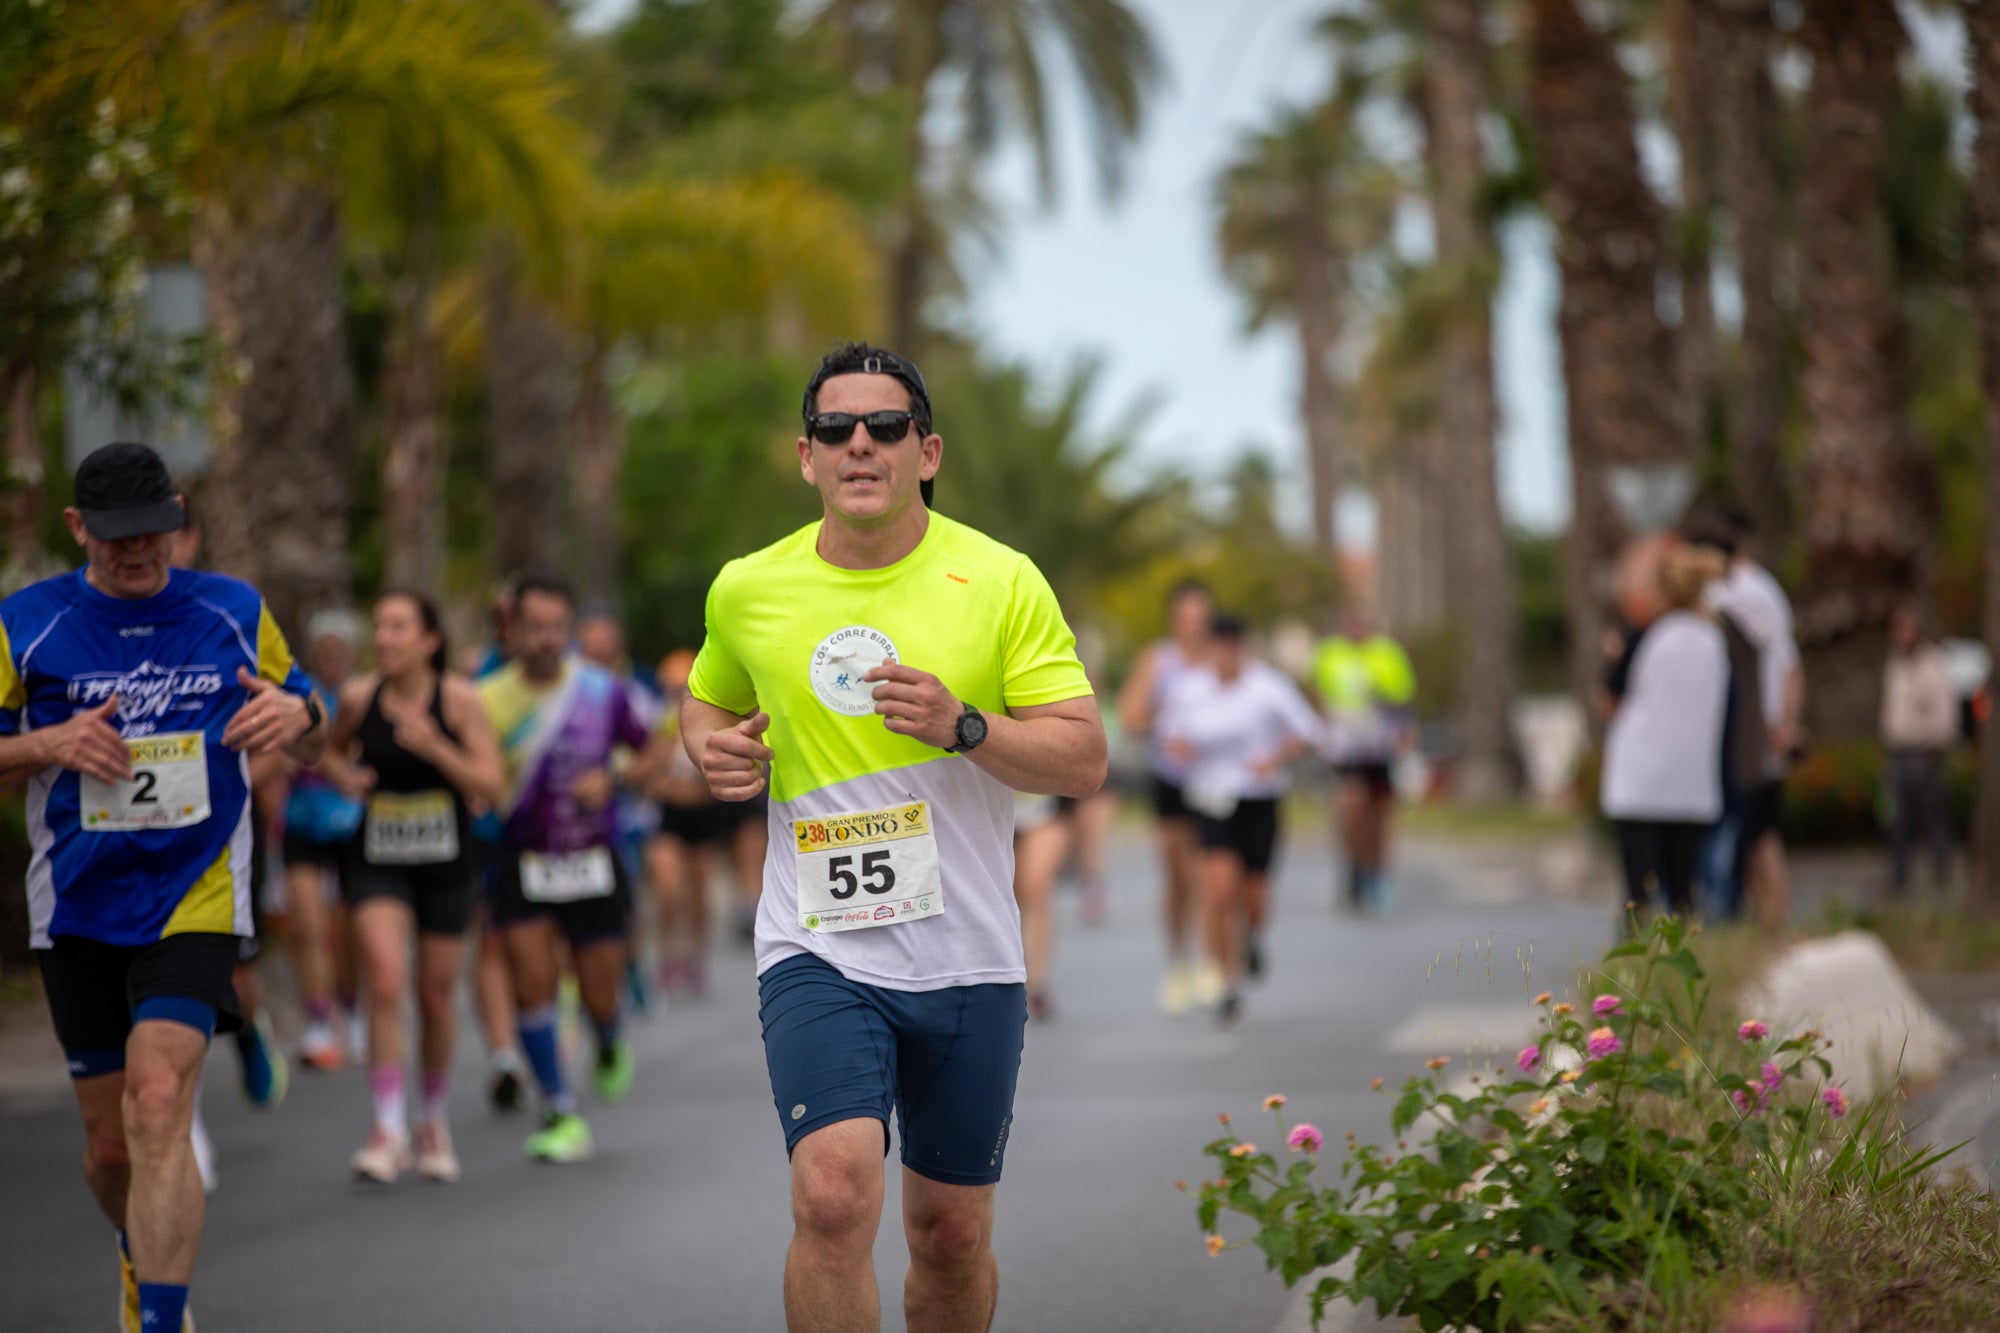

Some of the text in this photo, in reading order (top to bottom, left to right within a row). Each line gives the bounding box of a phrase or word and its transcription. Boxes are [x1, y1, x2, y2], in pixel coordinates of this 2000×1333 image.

[815, 646, 829, 666] LOS
[830, 629, 866, 645] CORRE
[130, 771, 158, 806] 2
[808, 824, 827, 843] 38
[825, 819, 898, 843] FONDO
[827, 817, 850, 828] GRAN
[852, 812, 889, 824] PREMIO
[829, 849, 896, 900] 55
